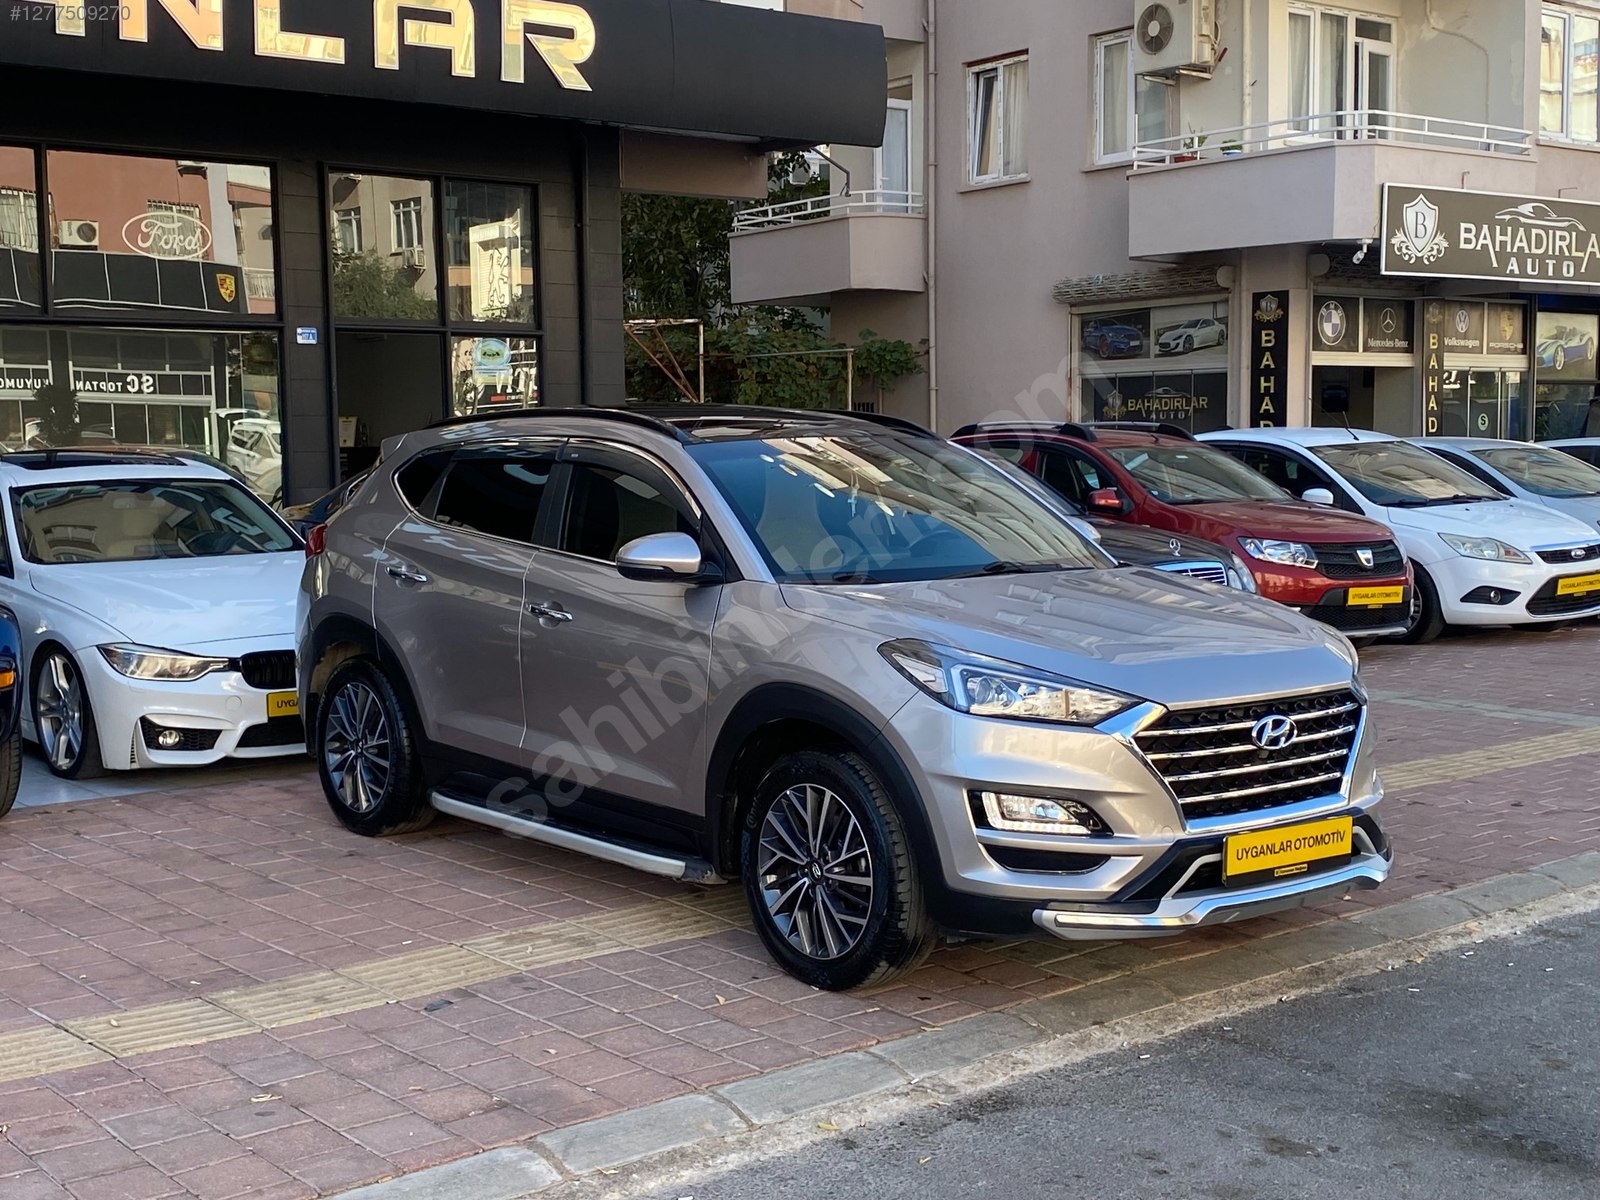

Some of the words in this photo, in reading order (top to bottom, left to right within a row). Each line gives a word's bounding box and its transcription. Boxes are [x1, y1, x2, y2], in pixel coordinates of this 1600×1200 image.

[137, 219, 201, 251] Ford
[1414, 211, 1428, 240] B
[1459, 222, 1600, 273] BAHADIRLA
[1506, 257, 1576, 278] AUTO
[1367, 338, 1409, 348] Mercedes-Benz
[1444, 337, 1480, 348] Volkswagen
[1428, 333, 1439, 433] BAHAD
[1127, 396, 1209, 418] BAHADIRLAR
[1150, 411, 1186, 420] AUTO
[1236, 840, 1293, 861] UYGANLAR
[1294, 829, 1347, 849] OTOMOTİV
